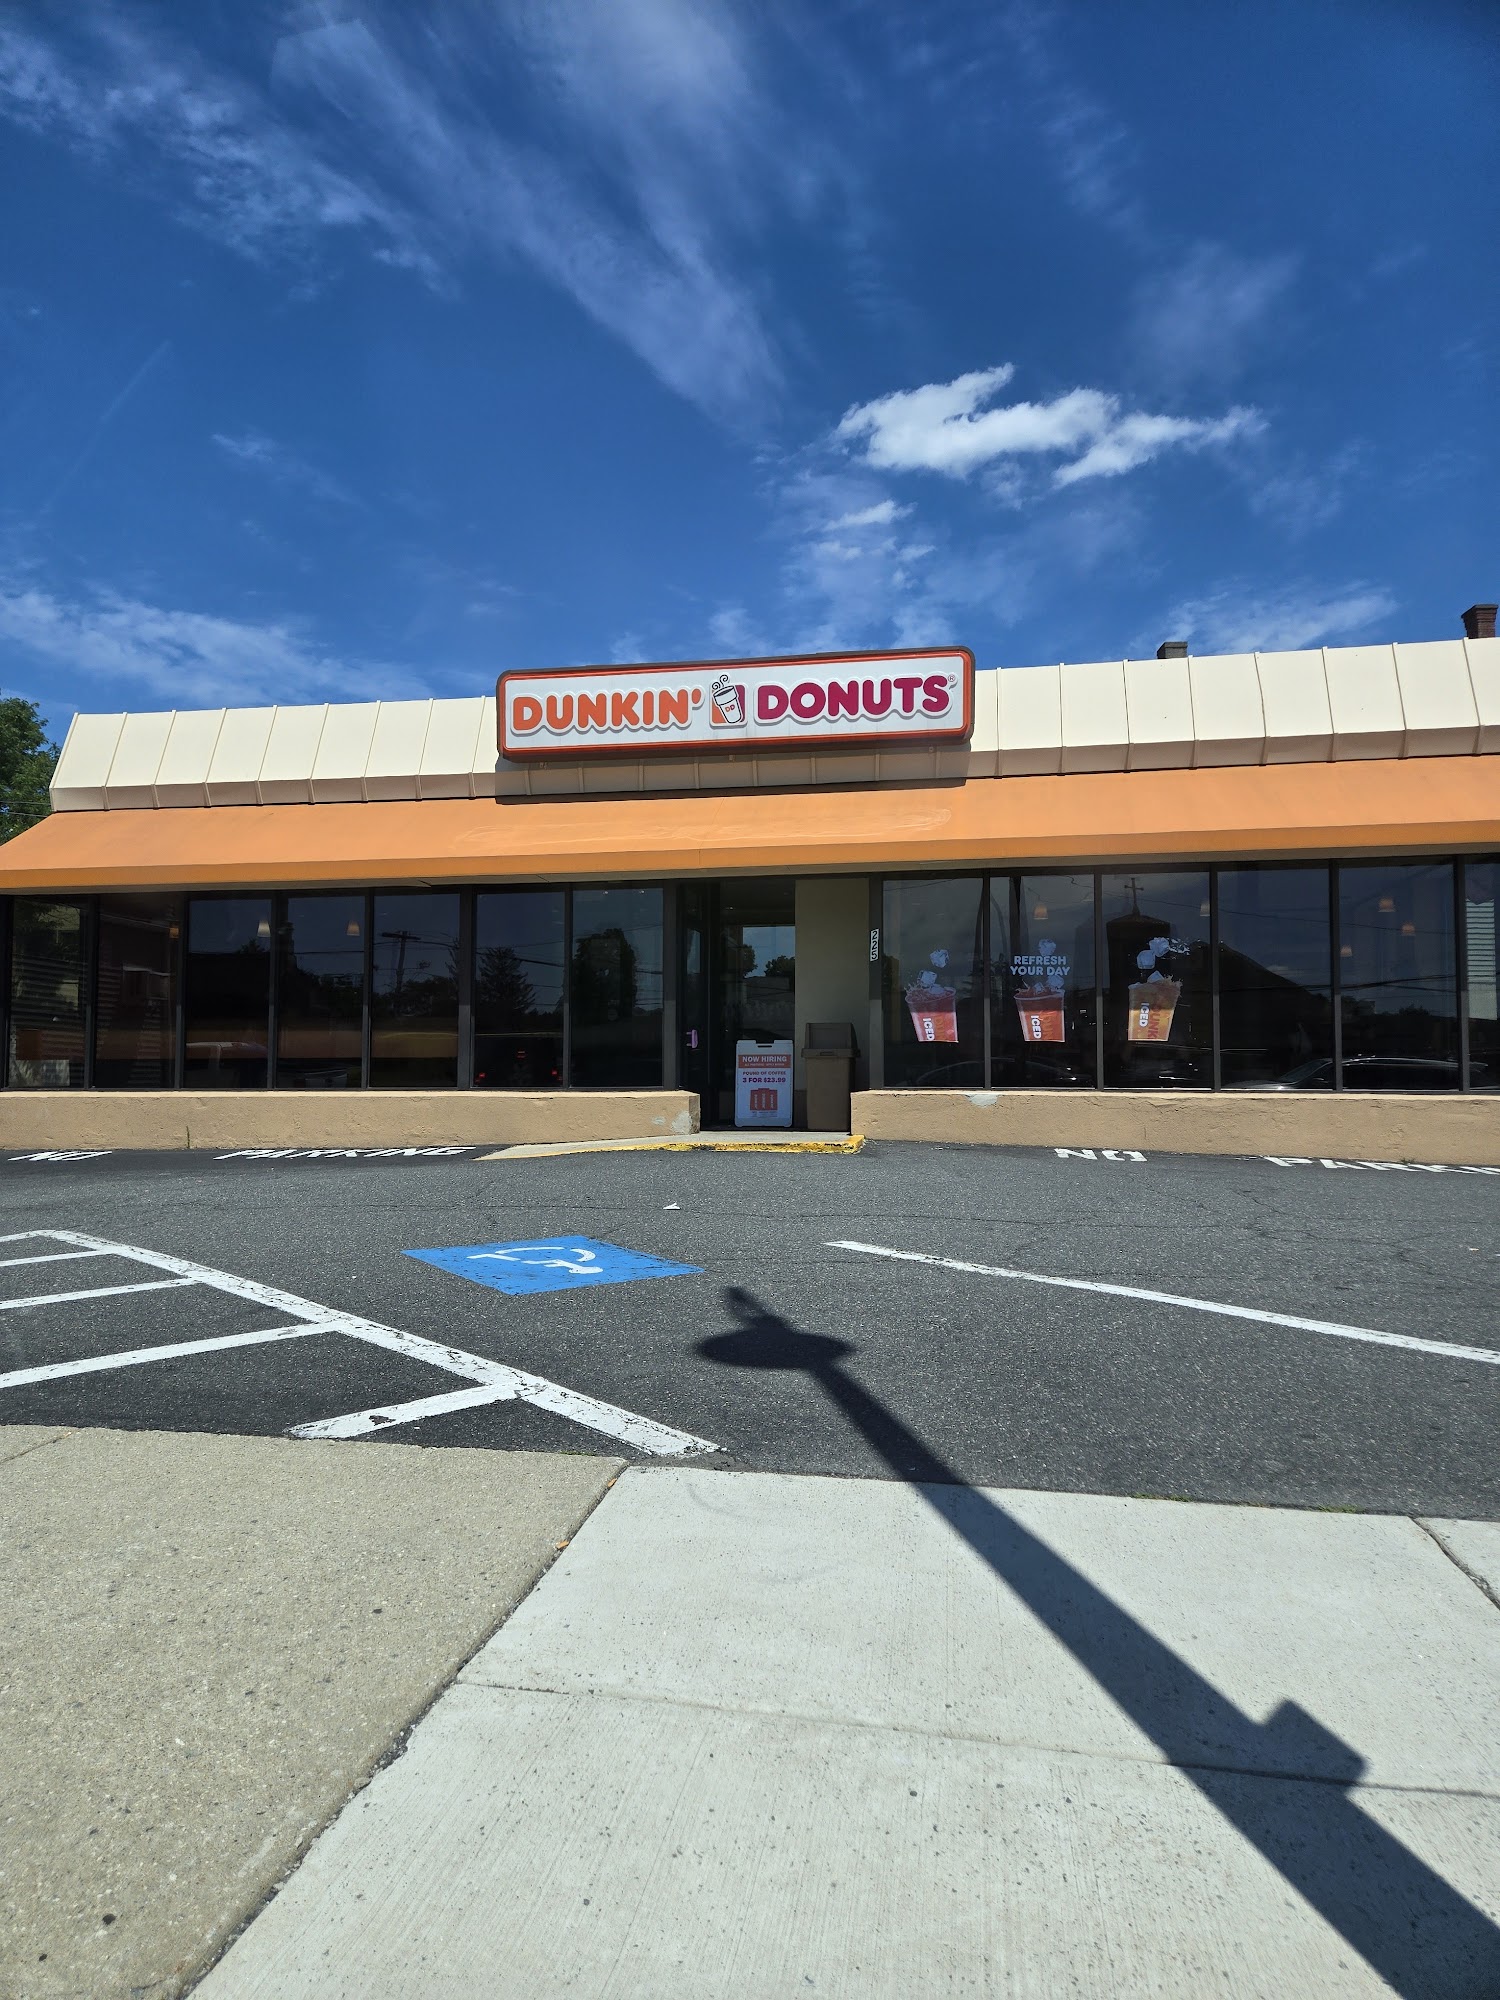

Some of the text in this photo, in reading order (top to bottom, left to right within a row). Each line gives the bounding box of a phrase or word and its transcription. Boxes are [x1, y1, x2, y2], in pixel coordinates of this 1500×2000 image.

[513, 688, 701, 731] DUNKIN'
[725, 704, 735, 712] DD
[757, 675, 949, 720] DONUTS
[1010, 966, 1070, 976] YOUR DAY
[1014, 955, 1066, 965] REFRESH
[1030, 1015, 1042, 1039] ICED
[1140, 1003, 1149, 1027] ICED
[922, 1017, 935, 1041] ICED
[1054, 1148, 1148, 1161] NO
